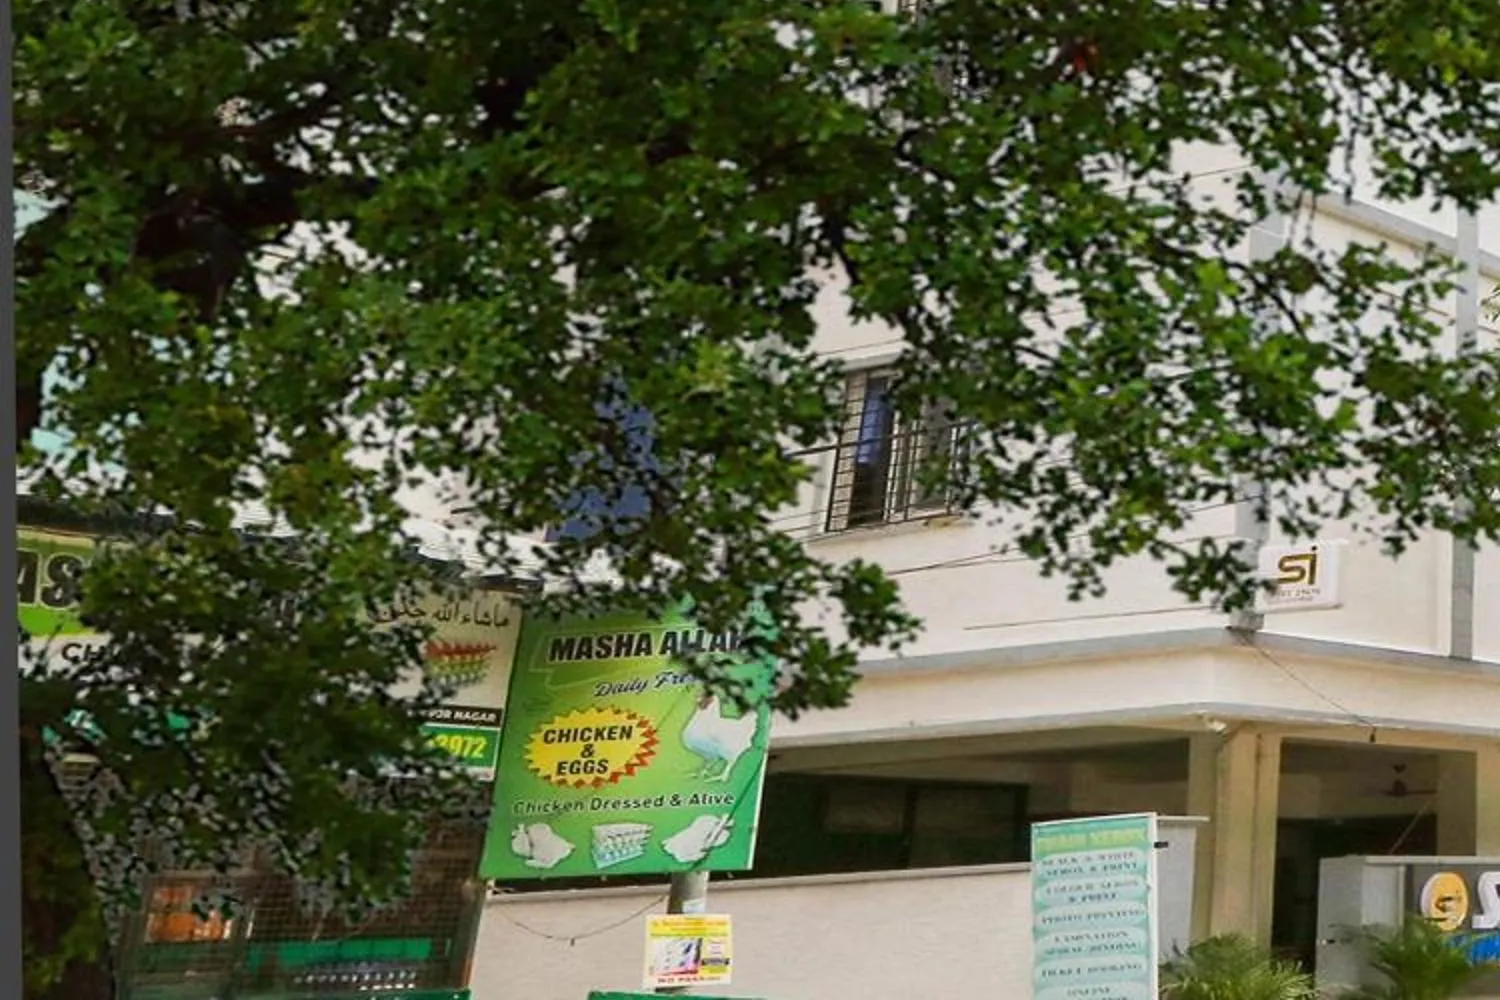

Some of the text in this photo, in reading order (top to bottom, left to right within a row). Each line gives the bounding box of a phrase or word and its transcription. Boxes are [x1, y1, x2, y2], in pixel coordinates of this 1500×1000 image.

[550, 633, 652, 661] MASHA
[594, 671, 698, 697] Daily Fre
[543, 725, 633, 745] CHICKEN
[579, 744, 596, 758] &
[555, 759, 609, 777] EGGS
[513, 792, 735, 816] Chicken Dressed & Alive
